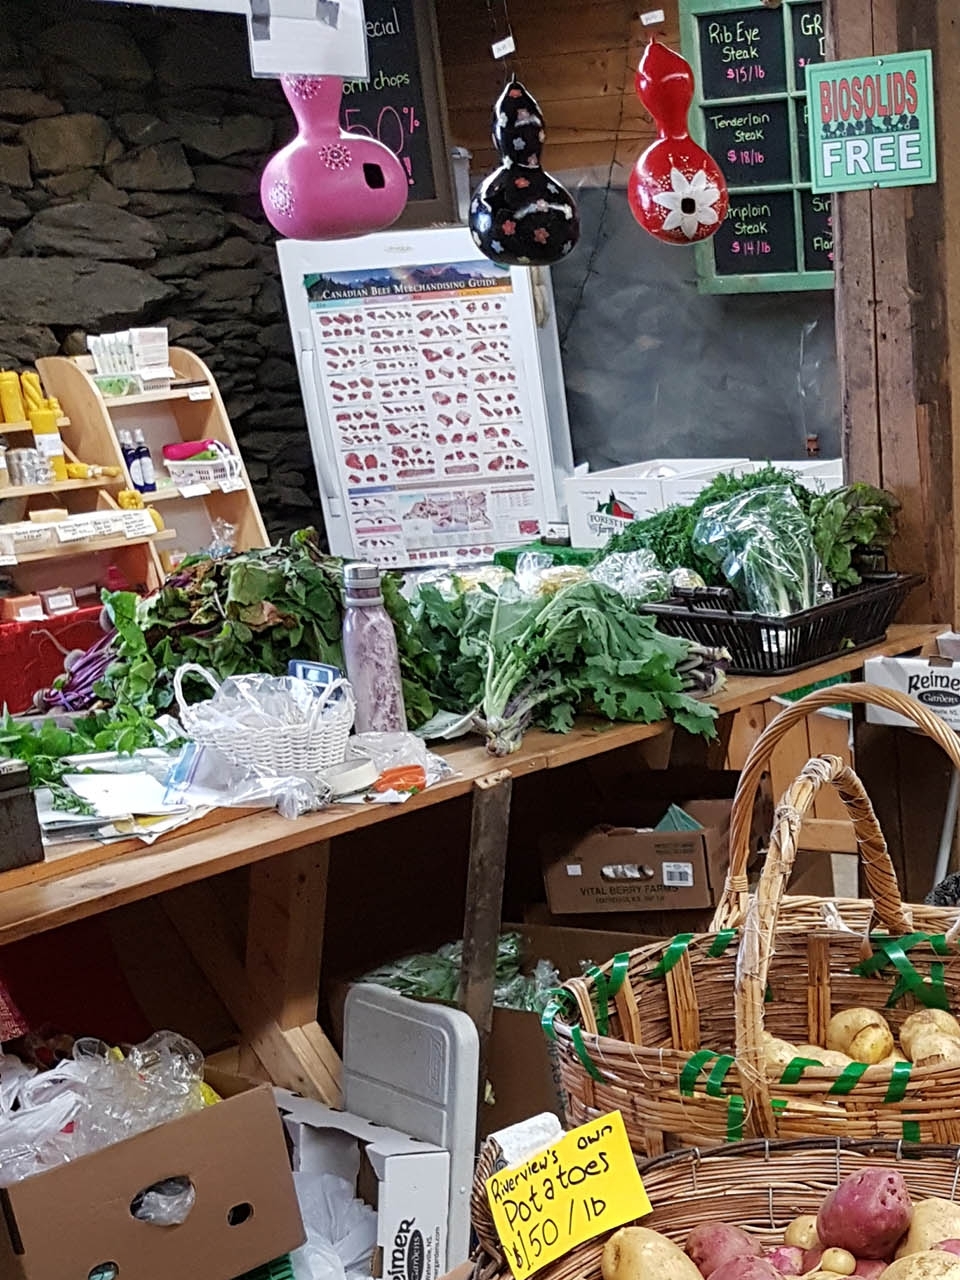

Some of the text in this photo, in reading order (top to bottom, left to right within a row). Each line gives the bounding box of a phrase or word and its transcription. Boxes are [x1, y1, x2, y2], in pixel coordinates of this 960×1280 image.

[366, 7, 400, 37] ecial
[708, 21, 761, 45] Rib Eye
[721, 45, 760, 63] Steak
[819, 69, 918, 125] BIOSOLIDS
[709, 112, 770, 130] Tenderloin
[734, 129, 765, 143] Steak
[822, 133, 923, 178] FREE
[734, 221, 768, 236] Steak
[491, 1125, 613, 1204] Riverview's own
